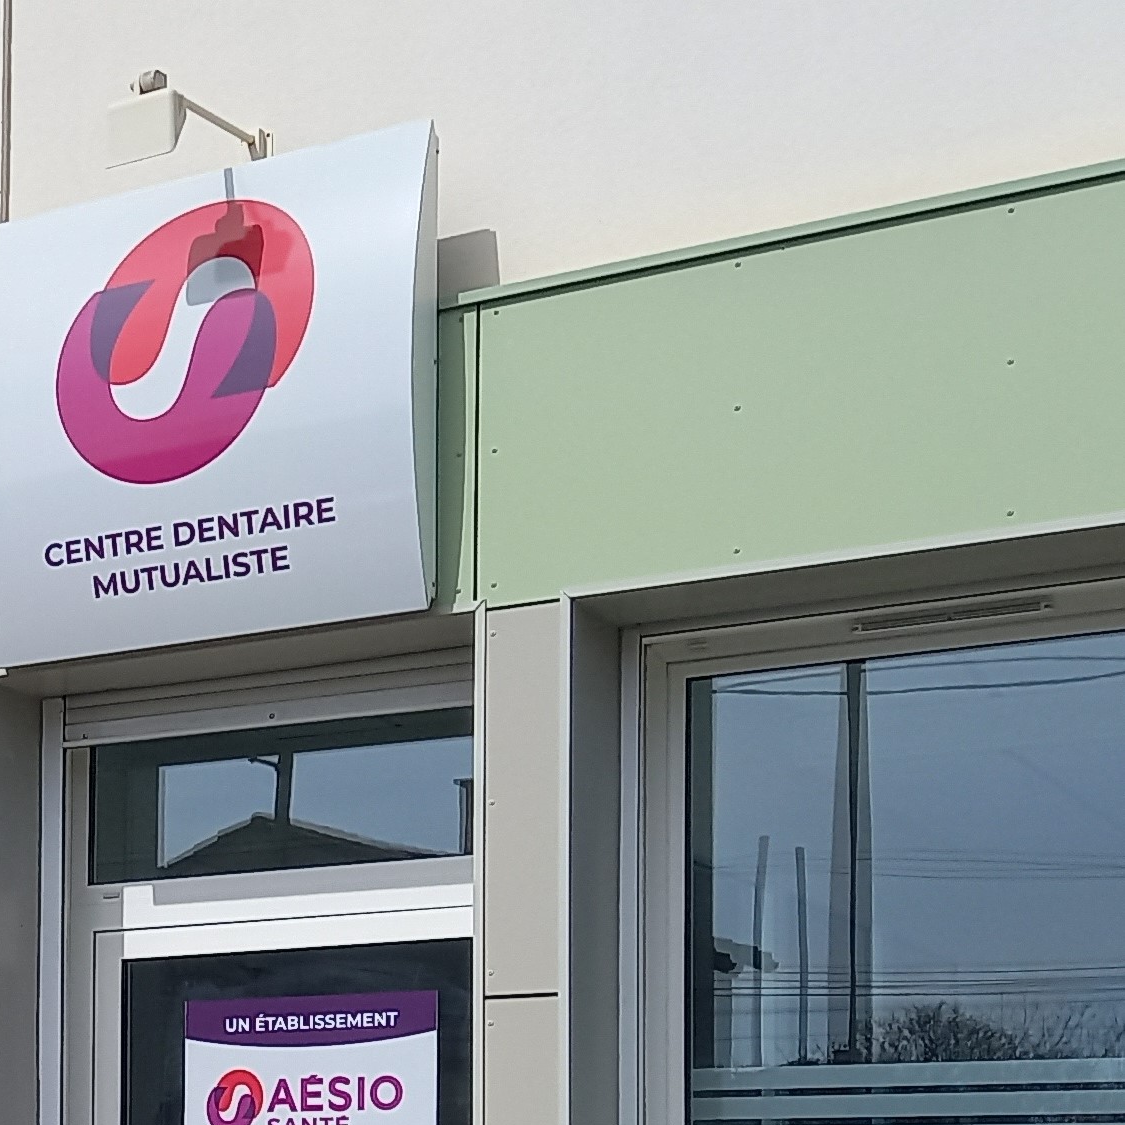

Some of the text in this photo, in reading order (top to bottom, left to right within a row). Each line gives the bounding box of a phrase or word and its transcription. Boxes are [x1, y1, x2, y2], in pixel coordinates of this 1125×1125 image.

[44, 496, 336, 567] CENTRE DENTAIRE
[92, 545, 290, 599] MUTUALISTE
[225, 1011, 399, 1033] UN ÉTABLISSEMENT
[266, 1074, 404, 1113] AÉSIO
